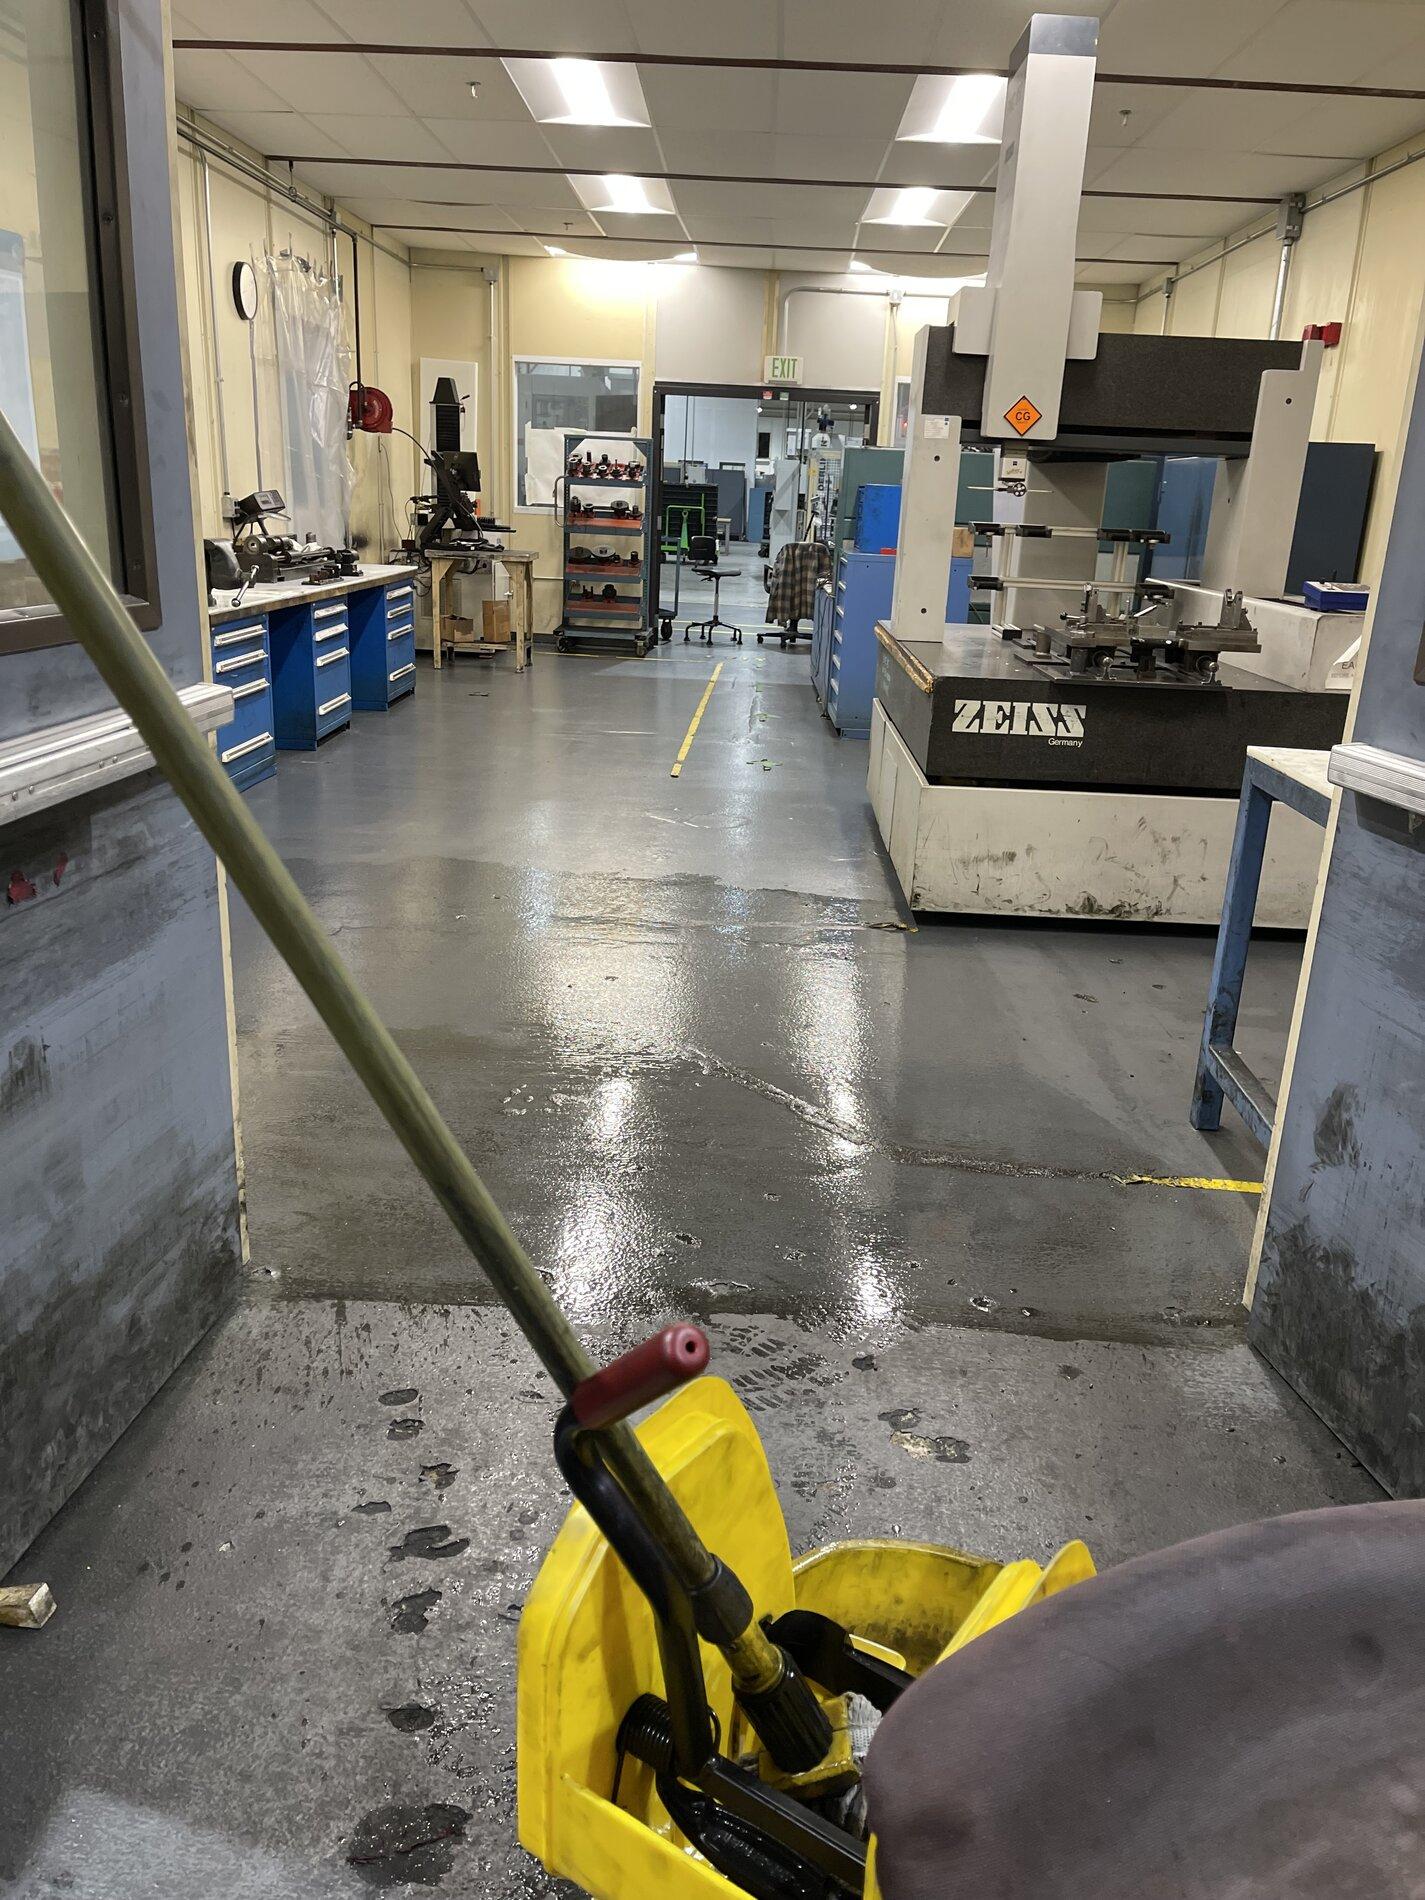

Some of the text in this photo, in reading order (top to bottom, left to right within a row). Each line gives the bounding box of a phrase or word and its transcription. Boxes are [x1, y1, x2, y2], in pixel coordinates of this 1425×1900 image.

[772, 357, 798, 379] EXIT
[1015, 411, 1031, 421] CG
[951, 699, 1087, 738] ZEISS
[1048, 737, 1084, 748] Germany
